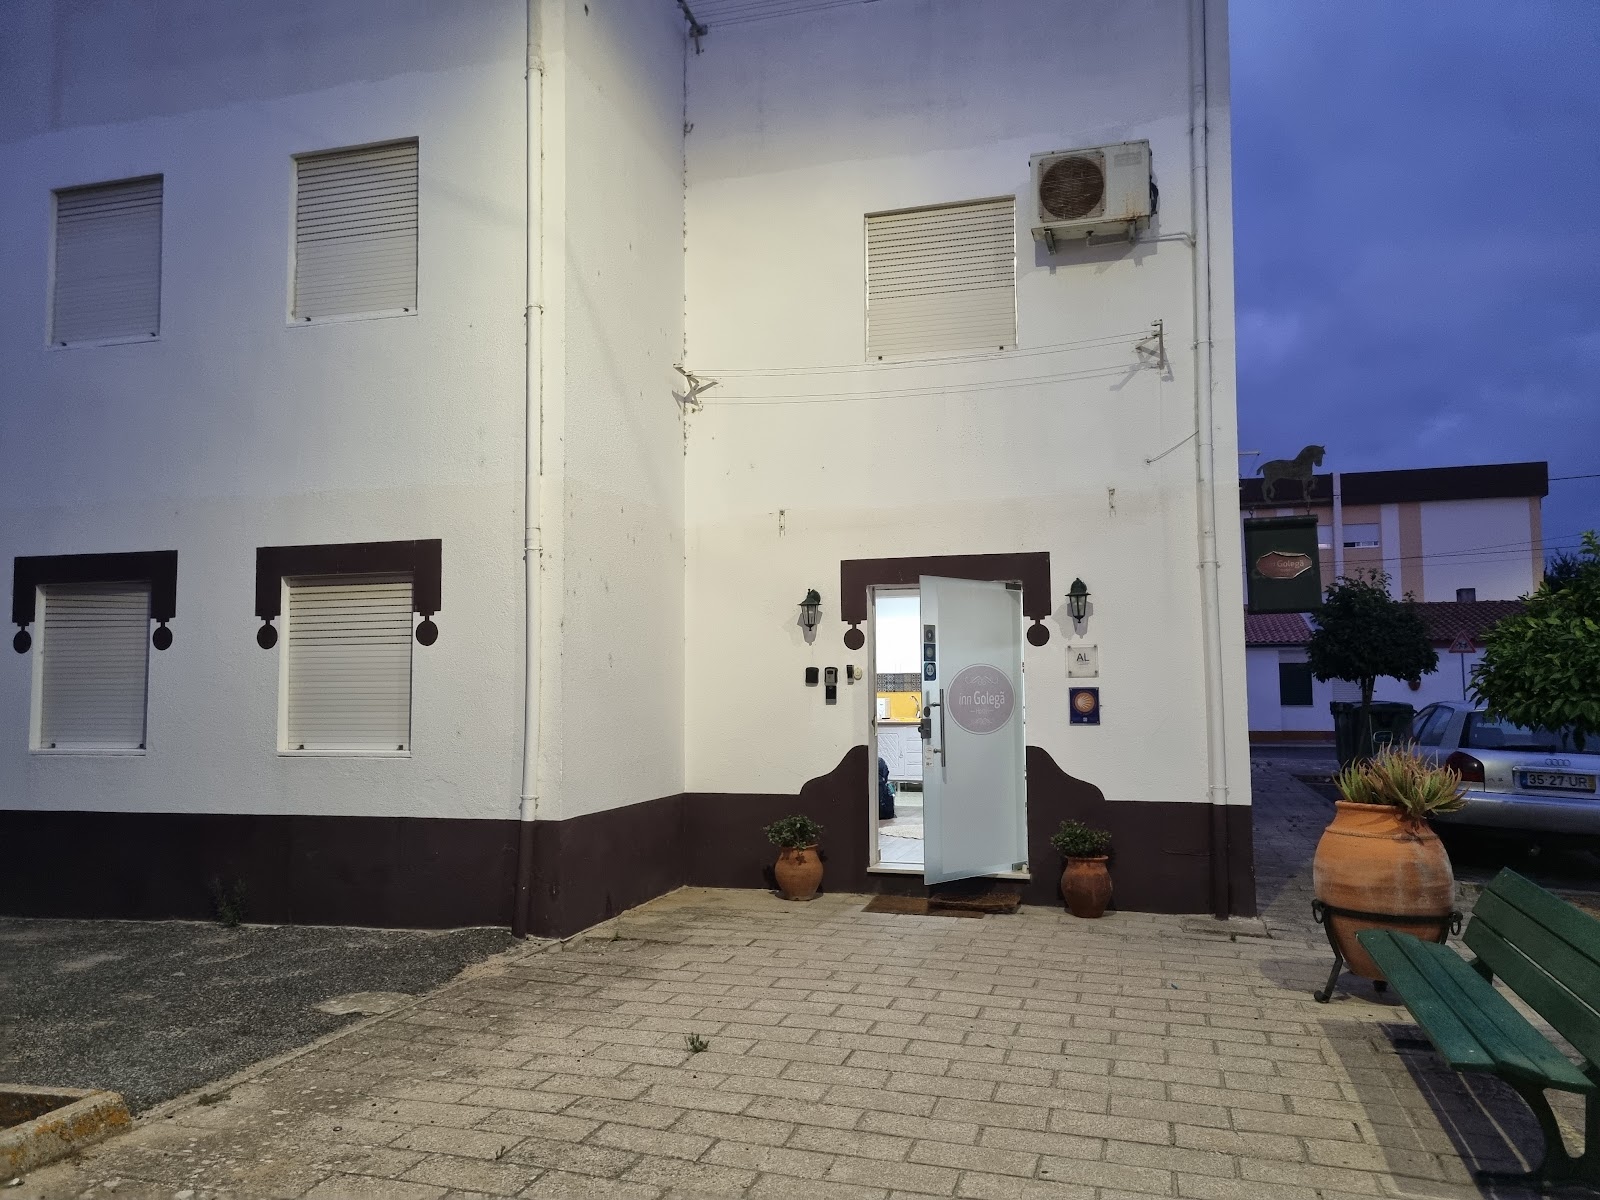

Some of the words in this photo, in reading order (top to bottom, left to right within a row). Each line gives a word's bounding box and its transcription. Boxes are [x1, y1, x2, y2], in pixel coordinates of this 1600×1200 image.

[1076, 652, 1090, 662] AL
[958, 692, 972, 705] inn
[973, 690, 1005, 709] Golegã
